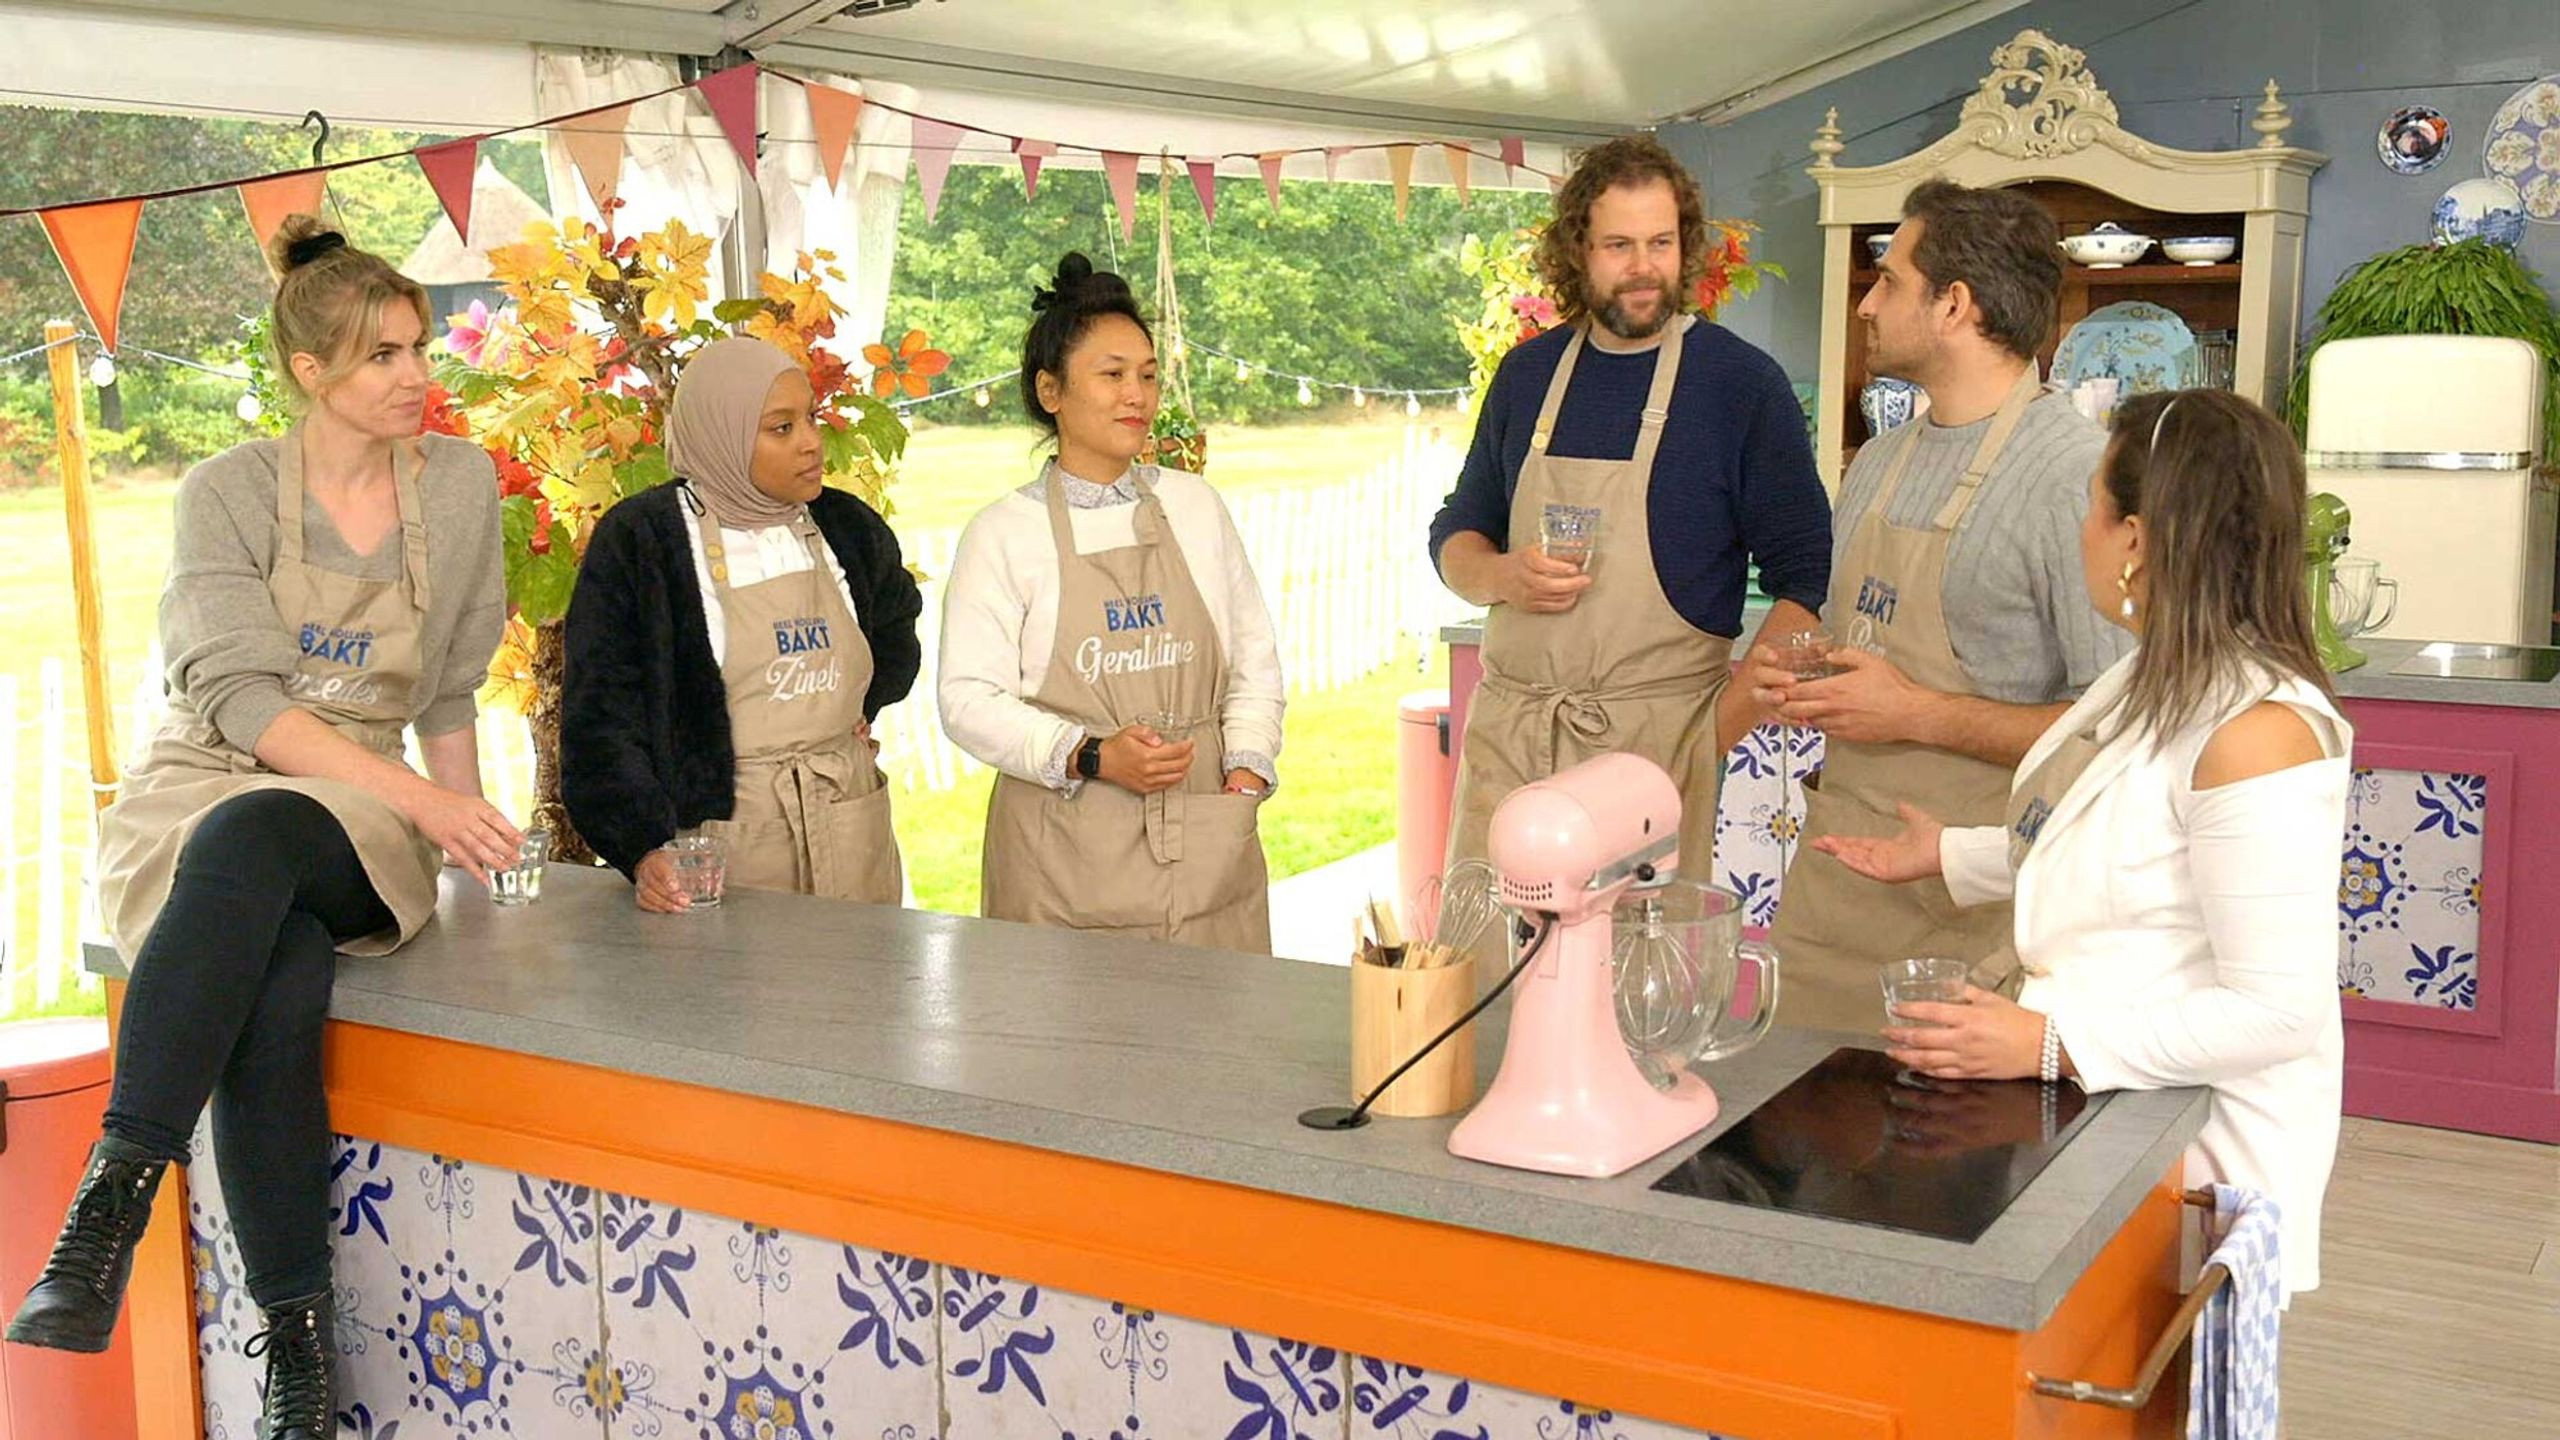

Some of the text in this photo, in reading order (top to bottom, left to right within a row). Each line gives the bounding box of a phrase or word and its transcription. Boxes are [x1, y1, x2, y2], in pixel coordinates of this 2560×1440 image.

[1106, 602, 1164, 632] BAKT
[1856, 584, 1896, 625] BAKT
[299, 629, 371, 667] BAKT
[775, 625, 830, 655] BAKT
[1075, 631, 1195, 685] Geraldine
[765, 654, 841, 702] Zineb
